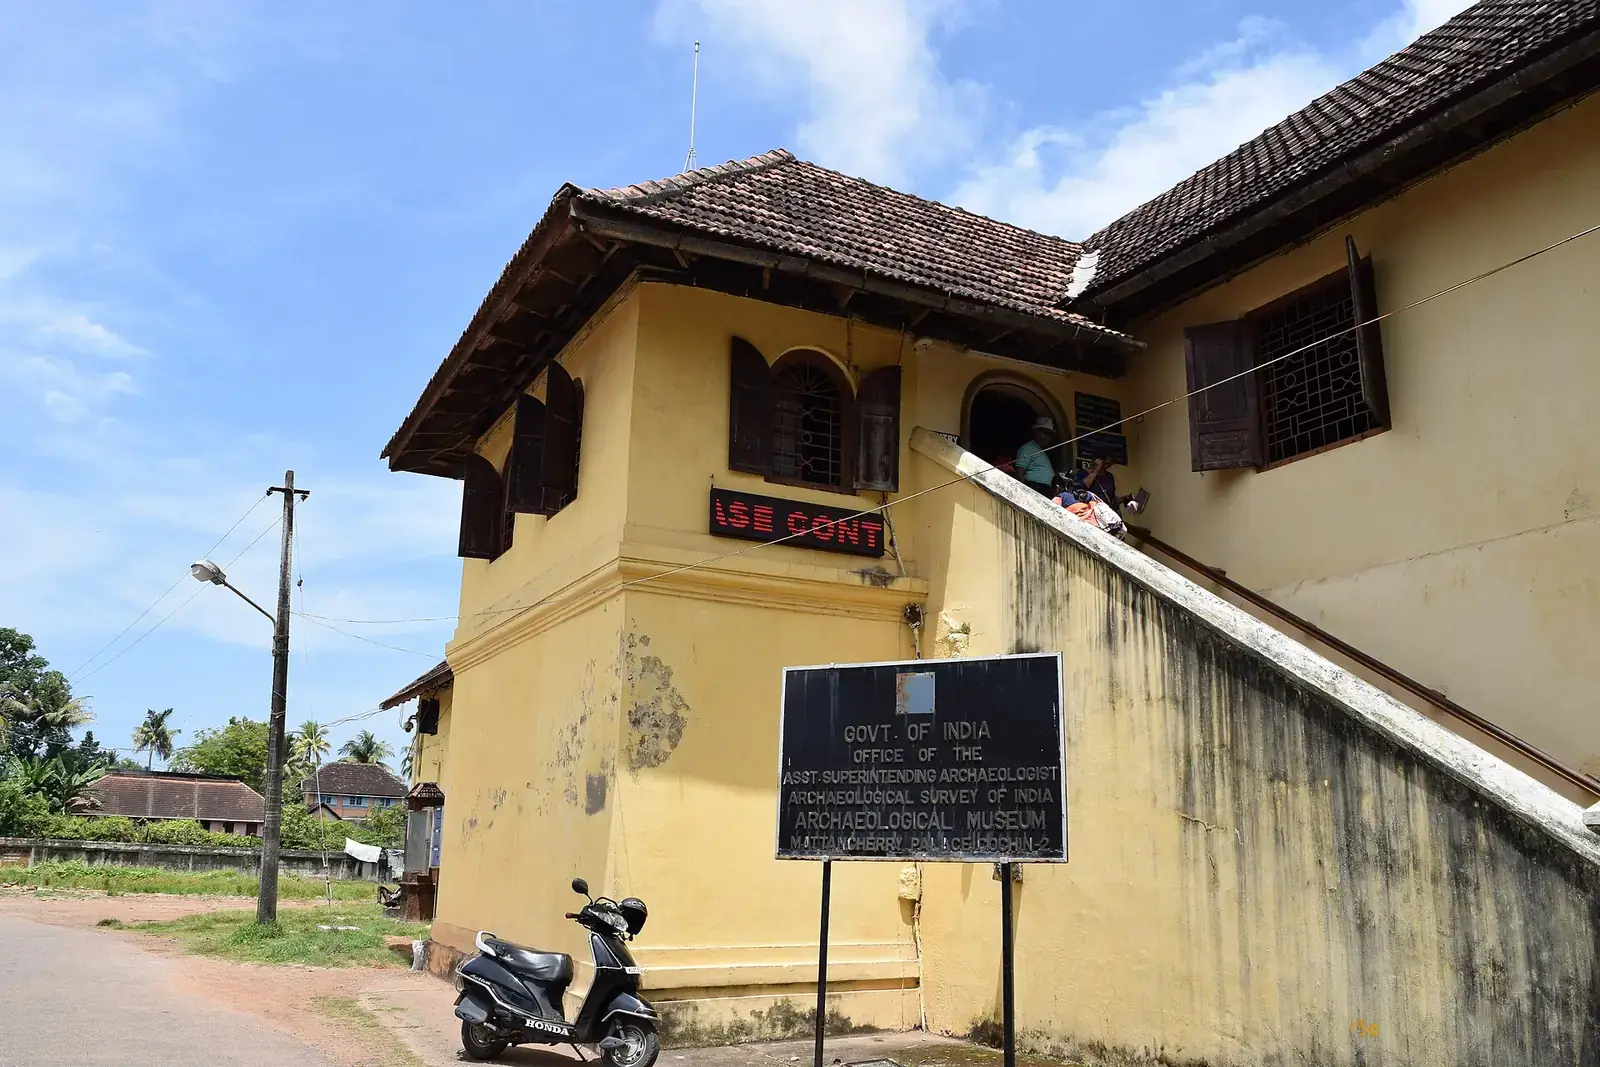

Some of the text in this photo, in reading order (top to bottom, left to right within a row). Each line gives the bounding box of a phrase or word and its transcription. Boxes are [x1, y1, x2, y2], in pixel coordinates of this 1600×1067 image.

[787, 511, 882, 548] CONT
[844, 720, 991, 743] GOVT. OF INDIA
[853, 746, 982, 763] OFFICE OF THE
[939, 765, 1059, 783] ARCHAEOLOGIST
[788, 788, 1054, 805] ARCHAEOLOGICAL SURVEY OF INDIA
[795, 810, 1046, 830] ARCHAEOLOGICAL MUSEUM
[524, 1019, 570, 1036] HONDA
